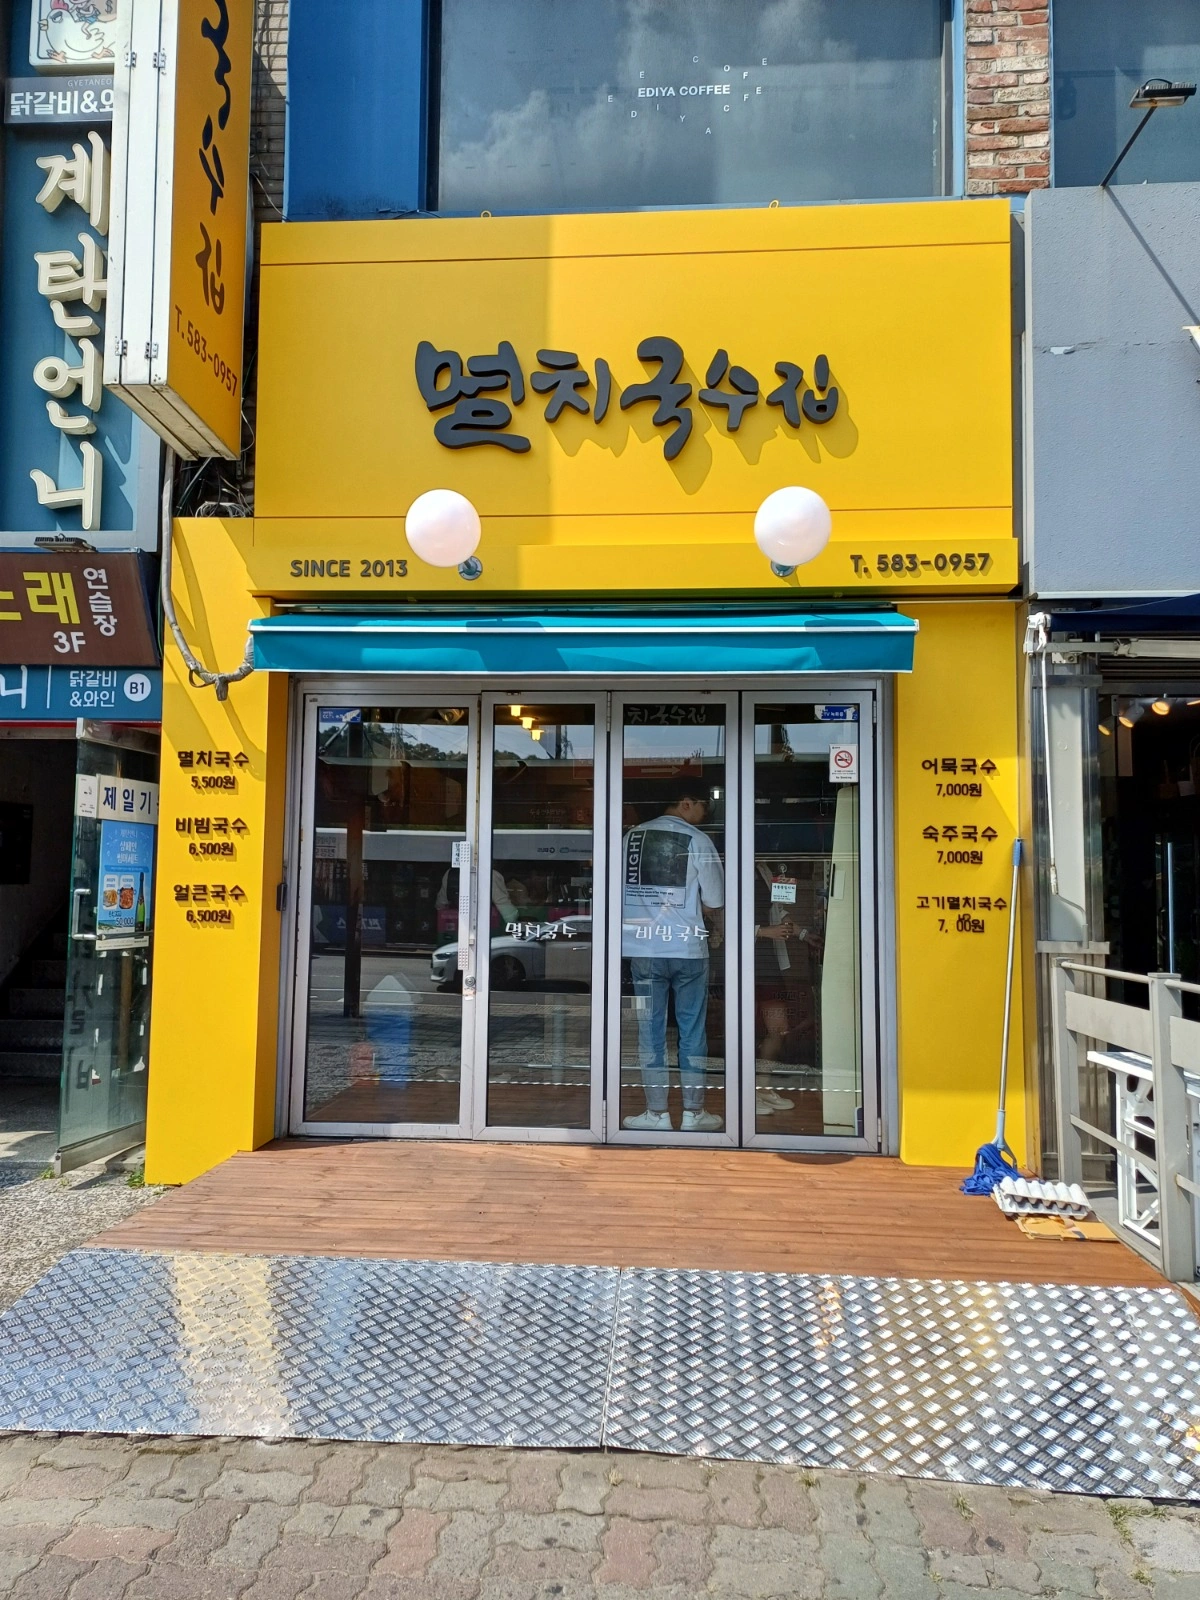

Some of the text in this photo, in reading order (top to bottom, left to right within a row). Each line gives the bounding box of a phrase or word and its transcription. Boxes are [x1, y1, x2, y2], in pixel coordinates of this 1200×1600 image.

[637, 84, 731, 98] EDIYA COFFEE
[415, 335, 839, 462] 멸치국수집
[290, 559, 408, 577] SINCE 2013
[876, 553, 990, 572] 583-0957
[83, 567, 117, 637] 연습장
[53, 631, 86, 654] 3F
[69, 670, 117, 688] 닭갈비
[129, 681, 145, 695] B1
[69, 690, 115, 708] &와인
[177, 750, 249, 768] 멸치국수
[921, 757, 997, 775] 어묵국수
[191, 775, 236, 790] 5,500원
[935, 783, 982, 798] 7,000원
[103, 786, 159, 815] 제일기
[175, 817, 248, 834] 비빔국수
[922, 825, 999, 842] 숙주국수
[188, 842, 234, 856] 6,500원
[628, 833, 642, 883] NIGHT
[936, 850, 983, 865] 7,000원
[173, 884, 246, 902] 얼큰국수
[916, 896, 1008, 911] 고기멸치국수
[186, 909, 231, 923] 6,500원
[505, 921, 577, 941] 멸치국수
[635, 924, 710, 942] 비빔국수
